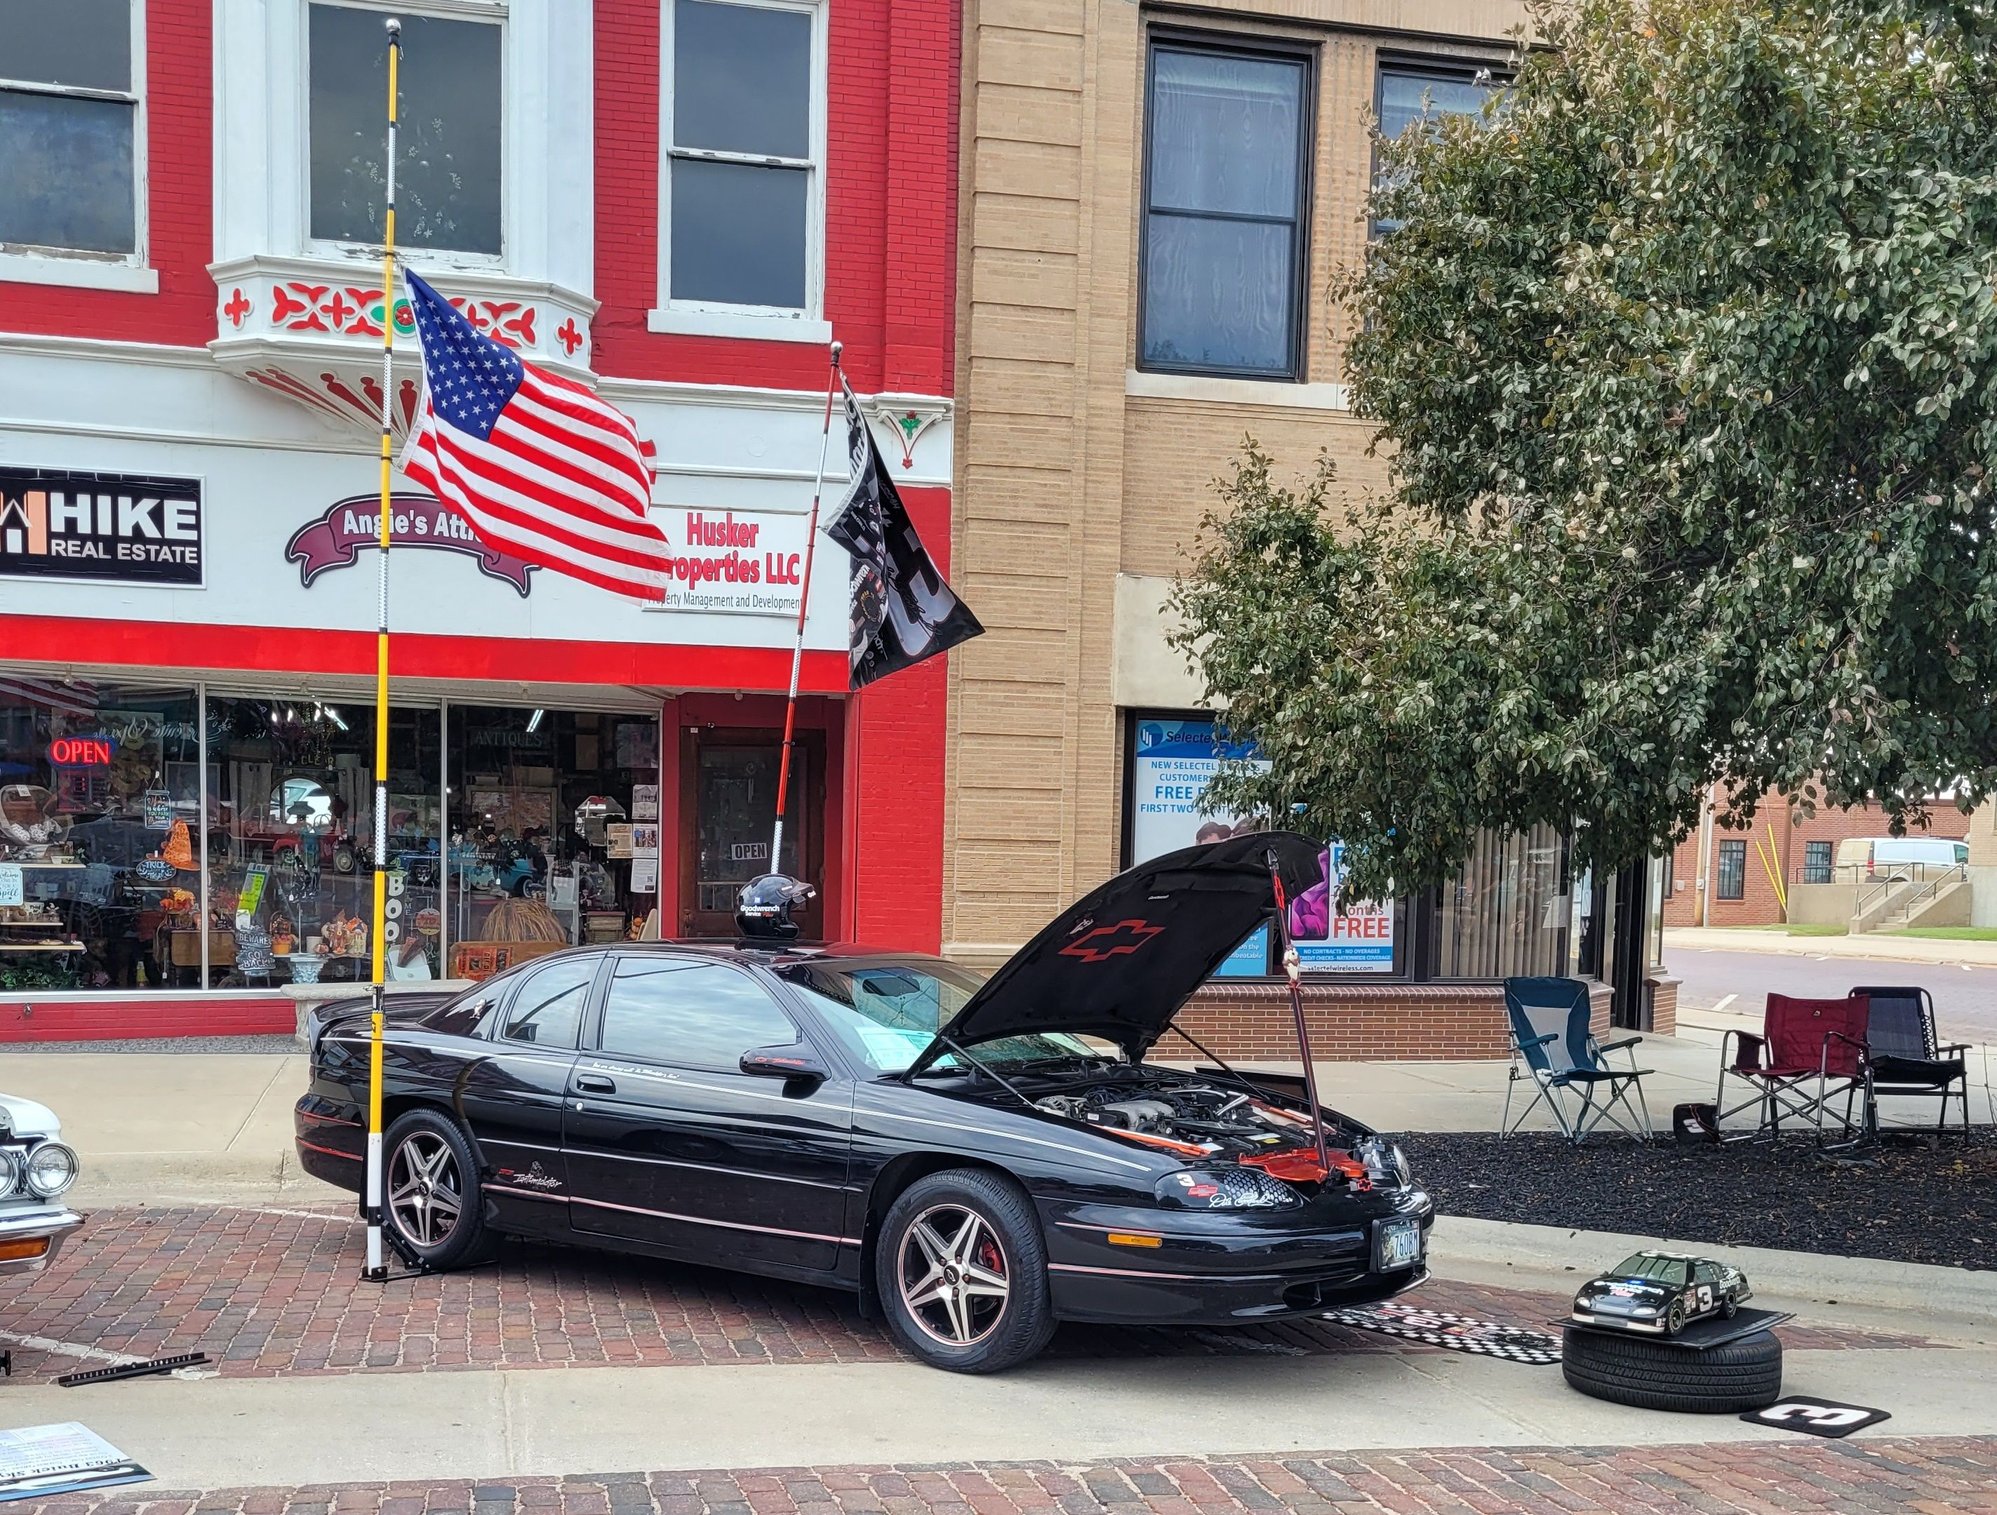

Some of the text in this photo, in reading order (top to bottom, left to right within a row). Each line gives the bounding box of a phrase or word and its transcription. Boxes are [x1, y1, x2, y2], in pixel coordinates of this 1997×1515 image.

[50, 491, 198, 540] HIKE
[433, 511, 482, 543] Atti
[686, 512, 759, 548] Husker
[51, 539, 198, 564] REAL ESTATE
[670, 550, 800, 590] roperties LLC
[683, 591, 736, 609] Management
[735, 594, 750, 607] and
[752, 595, 802, 612] Developmen
[52, 740, 110, 764] OPEN
[1151, 760, 1171, 770] NEW
[1174, 762, 1216, 771] SELECTEL
[1155, 785, 1193, 800] FREE
[1140, 803, 1168, 813] FIRST
[1171, 804, 1194, 814] TWO
[734, 844, 766, 859] OPEN
[1333, 917, 1390, 939] FREE
[1176, 1173, 1196, 1187] 3
[1697, 1284, 1713, 1313] 3
